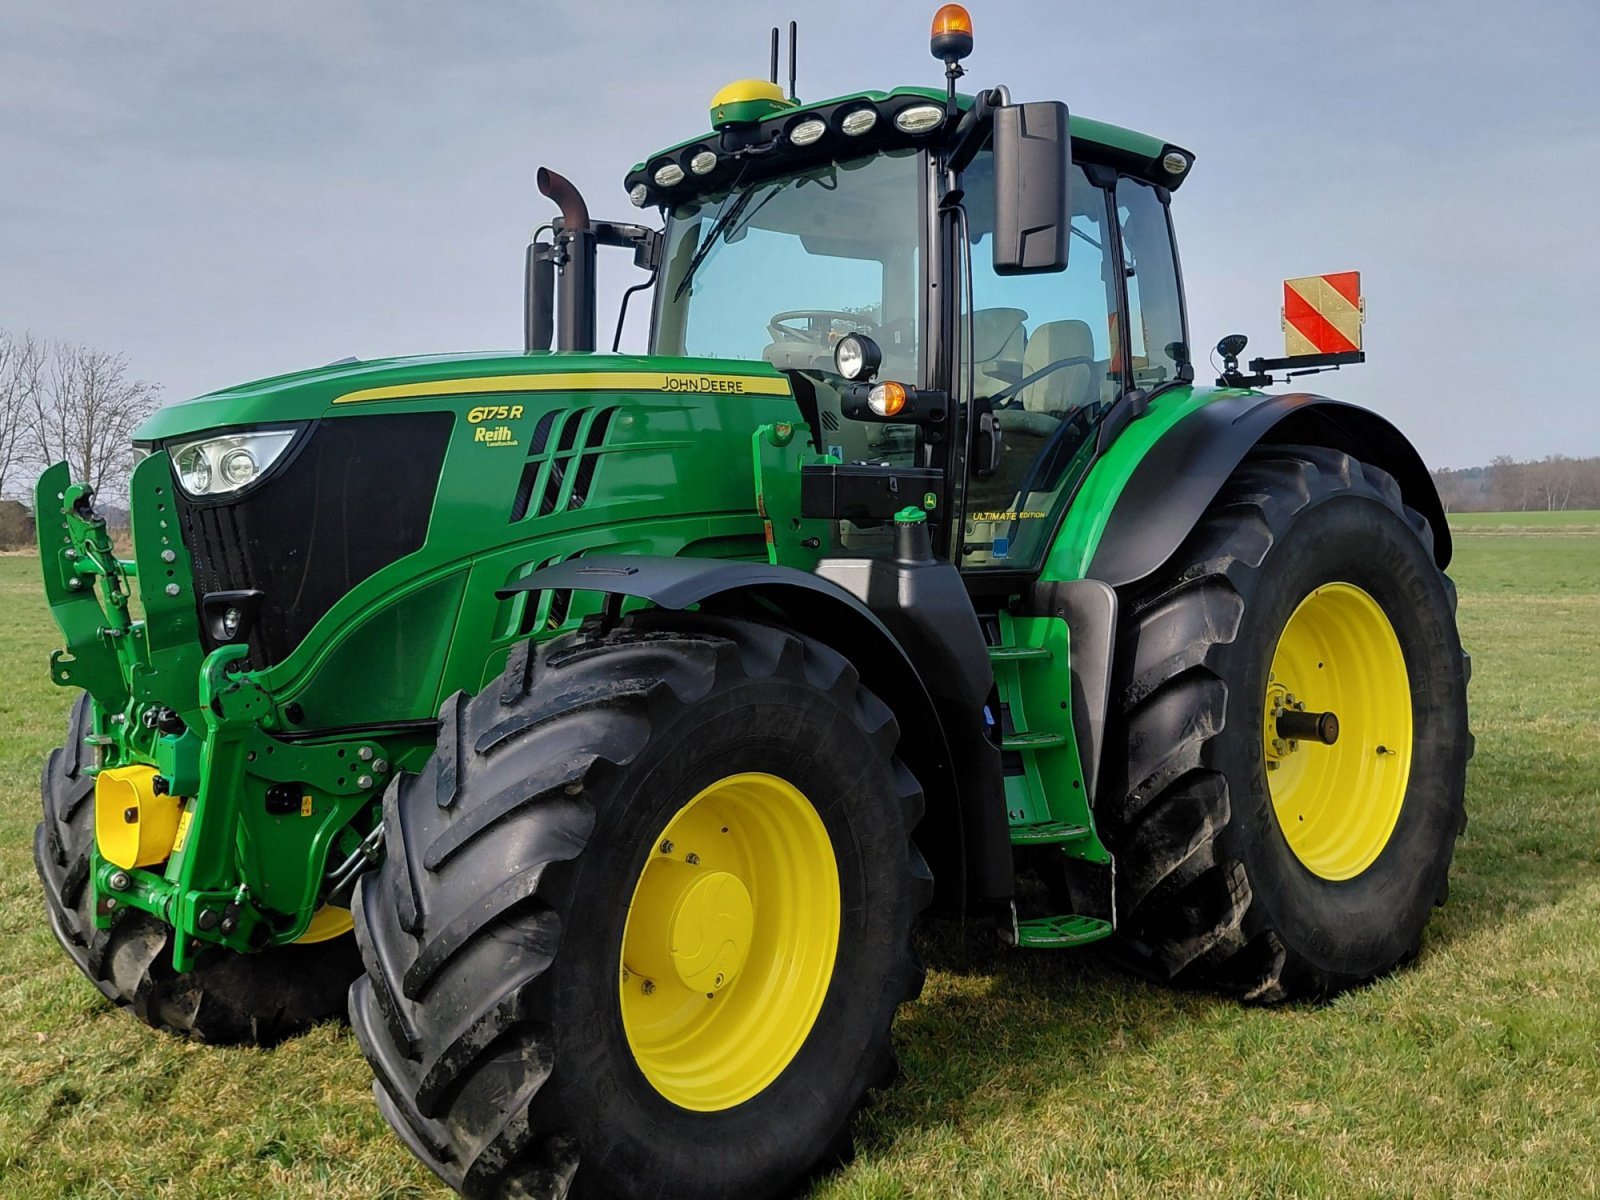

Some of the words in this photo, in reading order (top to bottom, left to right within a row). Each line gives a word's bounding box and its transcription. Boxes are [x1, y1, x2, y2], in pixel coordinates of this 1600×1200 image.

[661, 376, 698, 391] JOHN
[700, 377, 744, 392] DEERE
[474, 426, 512, 442] Reith
[972, 512, 1017, 521] ULTIMATE
[1019, 511, 1046, 519] EDITION
